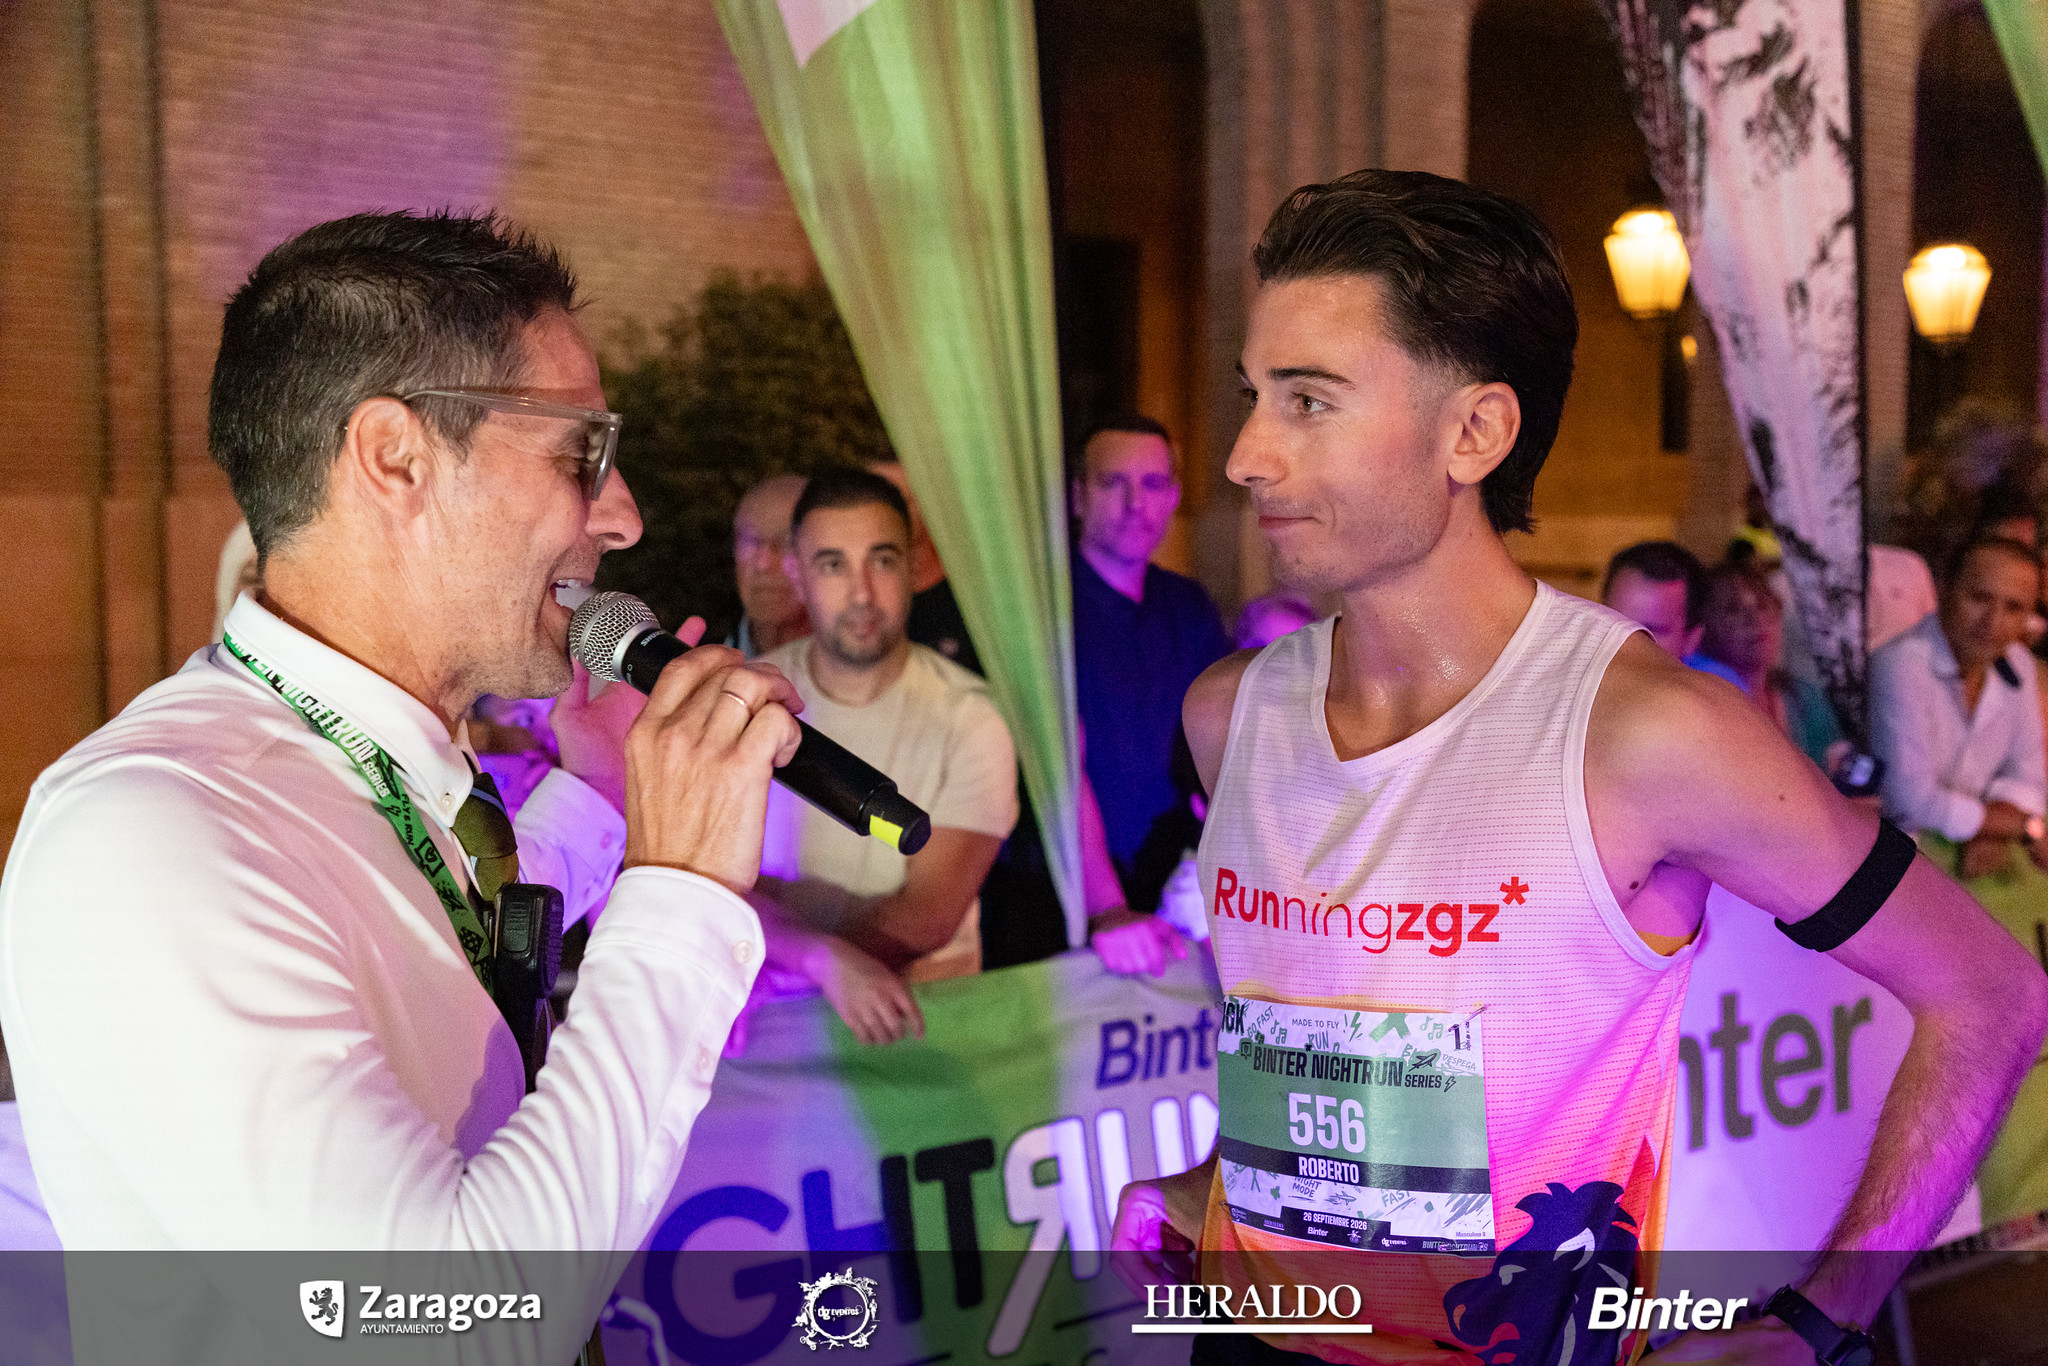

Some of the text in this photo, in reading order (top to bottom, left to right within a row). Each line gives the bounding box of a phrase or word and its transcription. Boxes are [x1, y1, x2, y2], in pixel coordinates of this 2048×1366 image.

[361, 761, 391, 798] SERIES
[1247, 1005, 1274, 1038] GO FAST
[1292, 1019, 1340, 1029] MADE TO FLY
[1253, 1046, 1443, 1088] BINTER NIGHTRUN SERIES
[1442, 1053, 1476, 1071] DESPEGA
[1288, 1092, 1366, 1154] 556
[1298, 1156, 1360, 1184] ROBERTO
[1292, 1182, 1315, 1198] MODE
[1303, 1212, 1368, 1231] 26 SEPTIEMBRE 2026
[1307, 1226, 1329, 1237] Binter
